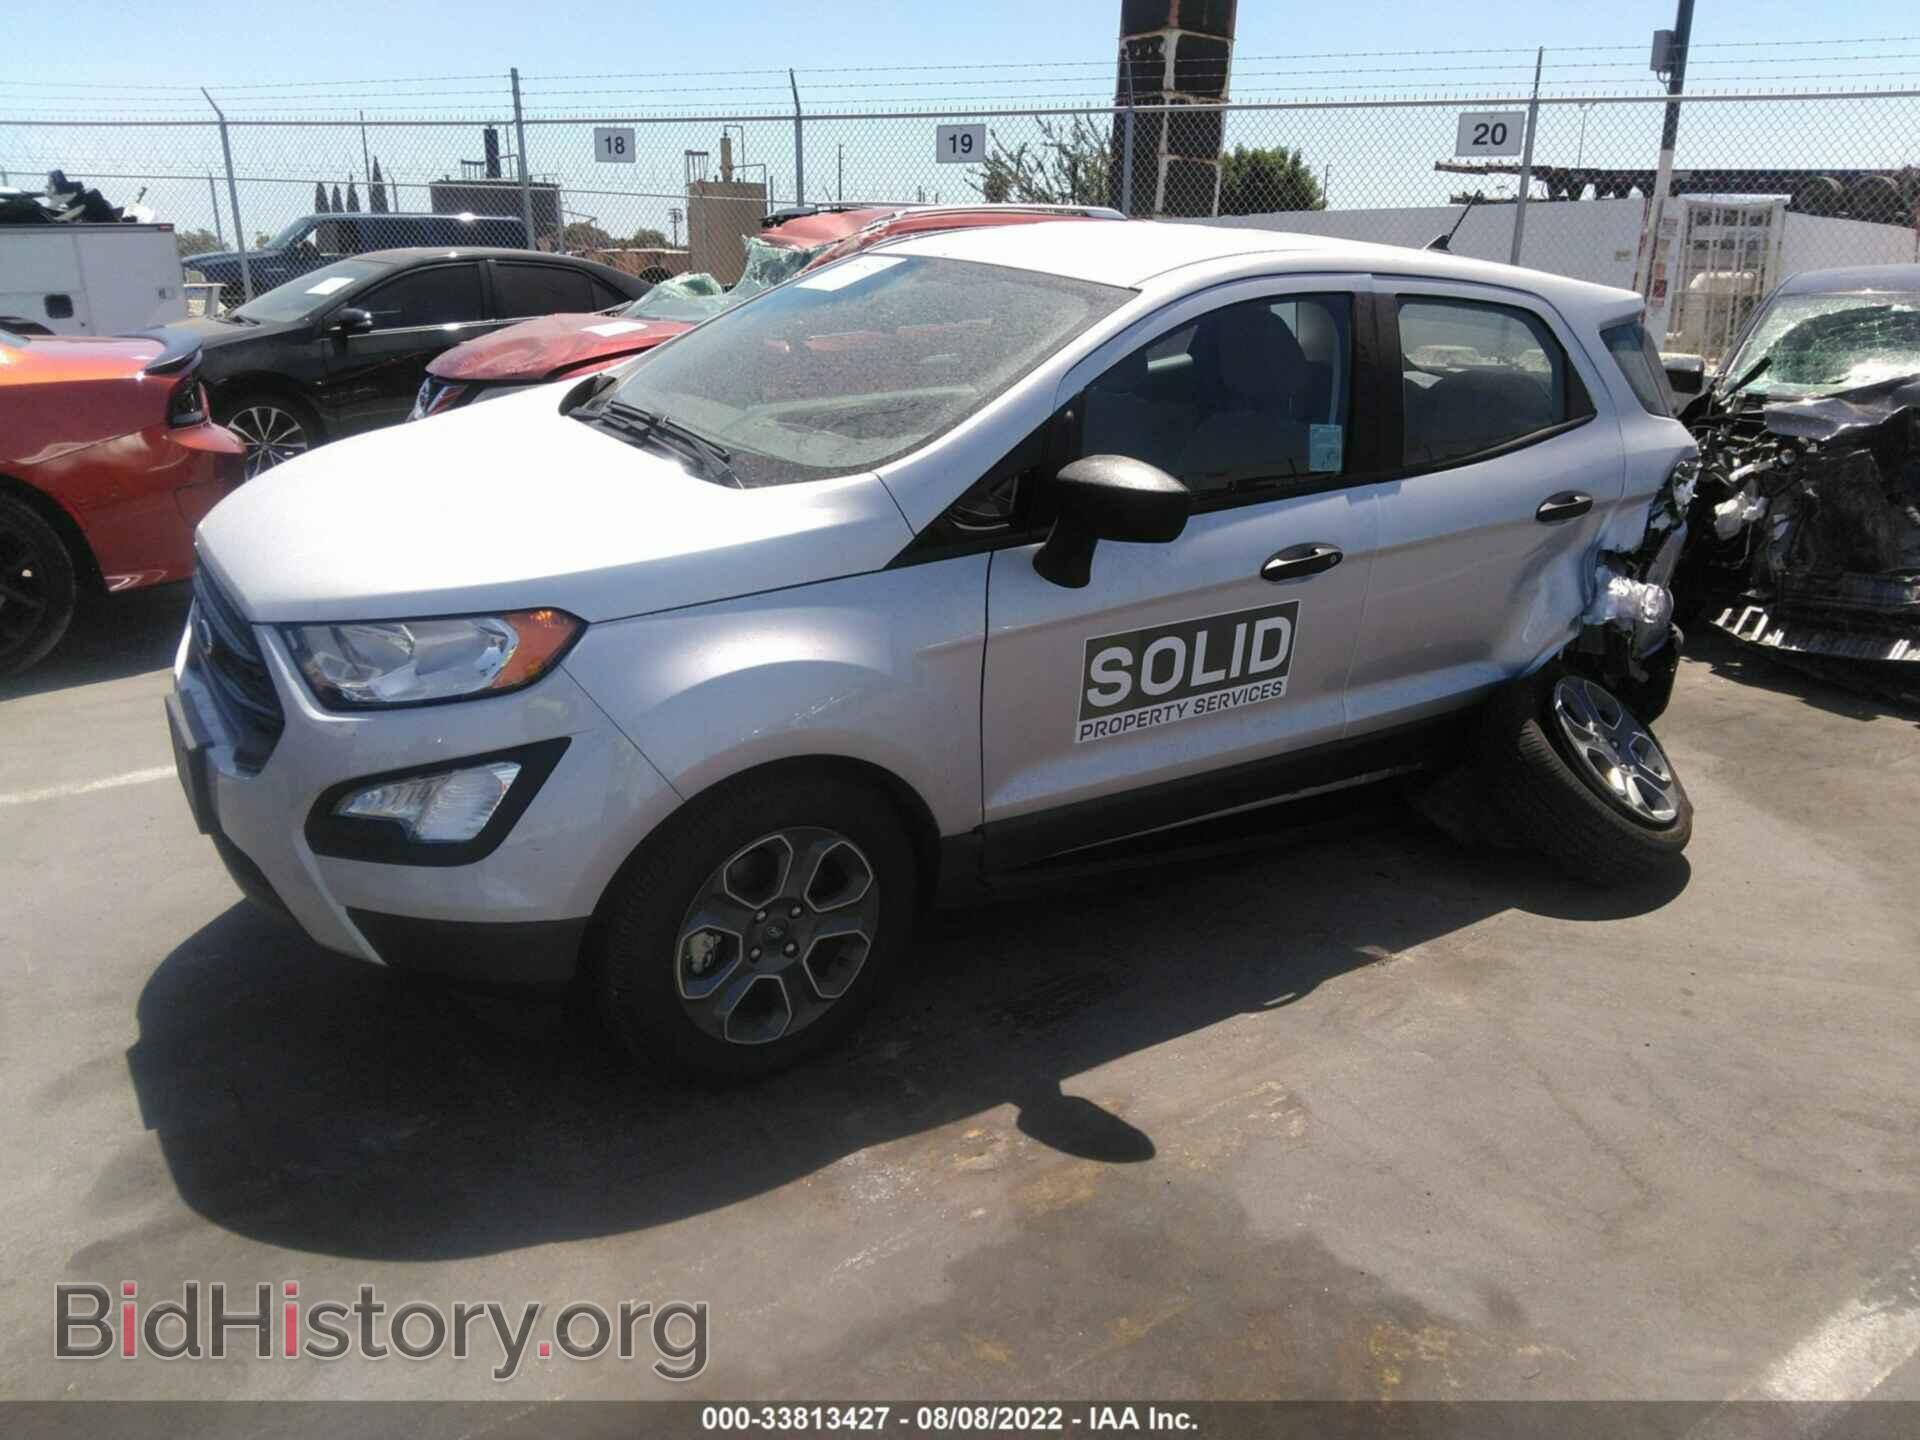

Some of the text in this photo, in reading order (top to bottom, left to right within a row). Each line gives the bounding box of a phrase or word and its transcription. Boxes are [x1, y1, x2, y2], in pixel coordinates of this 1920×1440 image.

[604, 136, 625, 154] 18
[948, 134, 973, 154] 19
[1472, 122, 1507, 146] 20
[1087, 616, 1292, 708] SOLID
[1079, 680, 1283, 741] PROPERTY SERVICES
